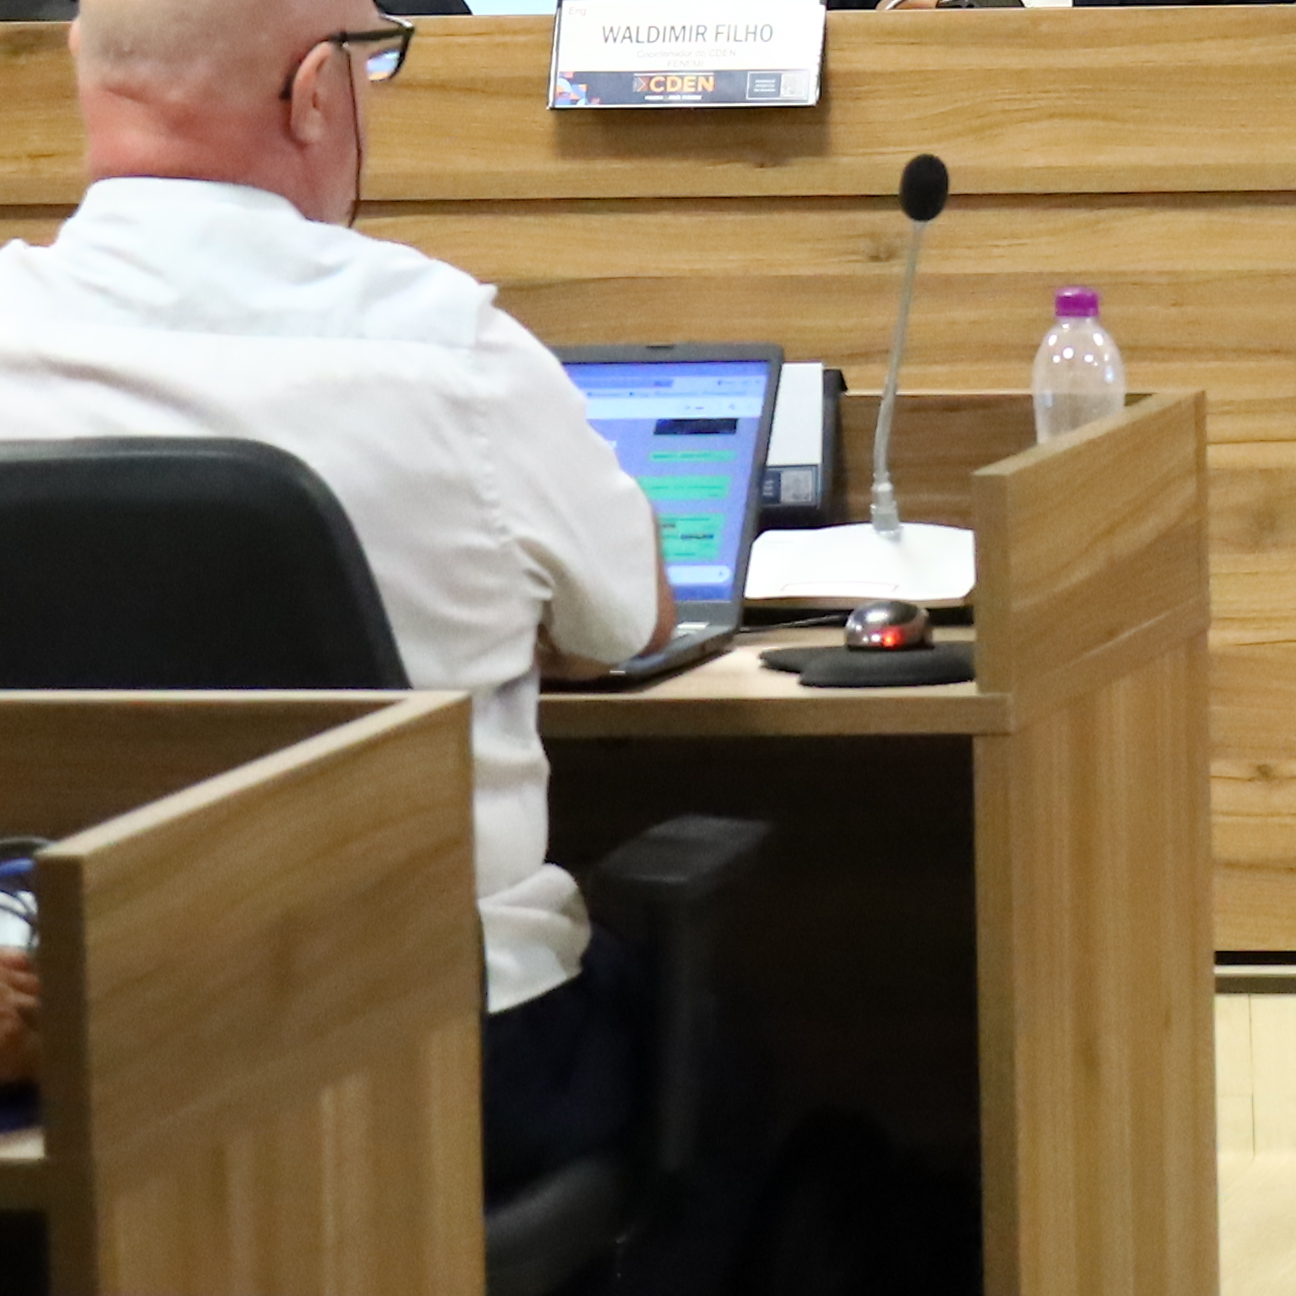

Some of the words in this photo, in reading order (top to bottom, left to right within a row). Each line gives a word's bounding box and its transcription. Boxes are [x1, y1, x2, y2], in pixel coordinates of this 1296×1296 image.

[601, 24, 708, 44] WALDIMIR
[713, 23, 774, 44] FILHO
[648, 74, 716, 93] CDEN
